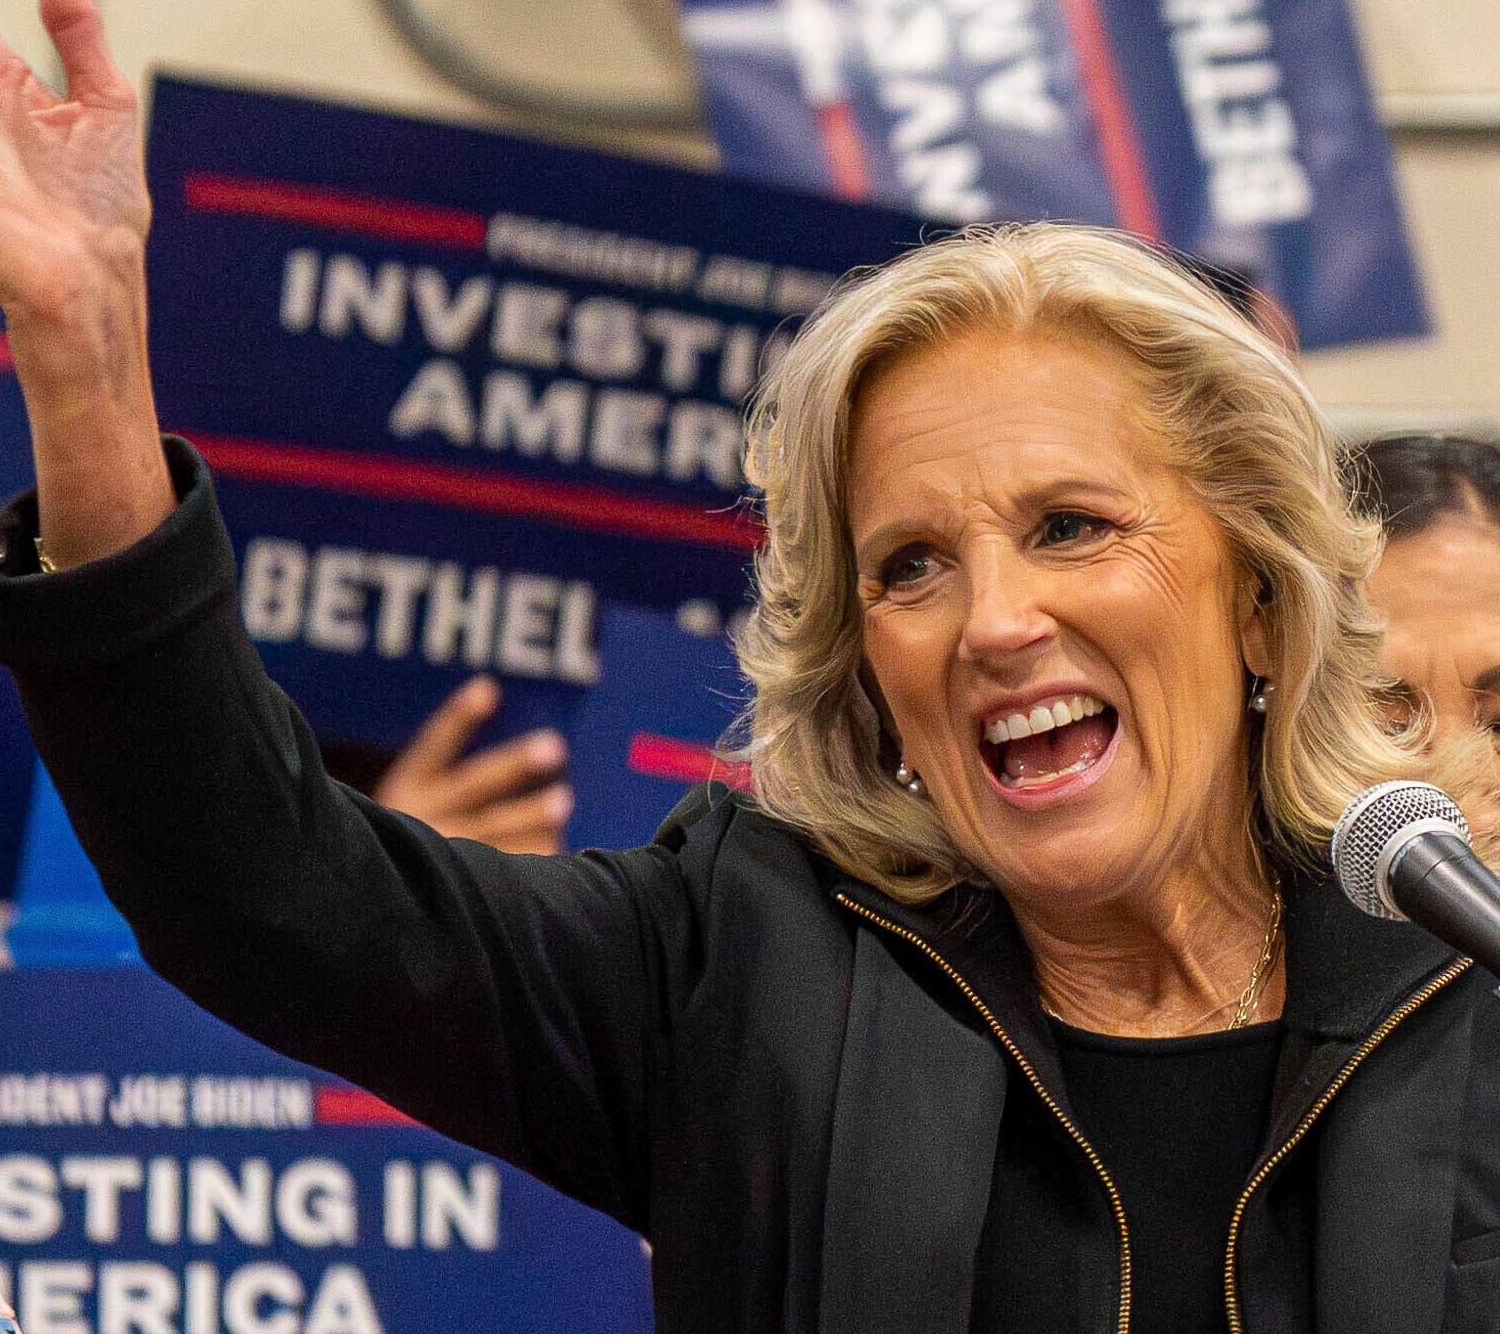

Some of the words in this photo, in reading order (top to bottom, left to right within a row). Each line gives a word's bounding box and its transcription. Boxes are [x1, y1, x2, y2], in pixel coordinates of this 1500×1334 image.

[278, 247, 788, 402] INVESTI
[109, 1075, 190, 1128] JOE
[191, 1076, 314, 1129] BIDEN
[383, 1161, 500, 1251] IN
